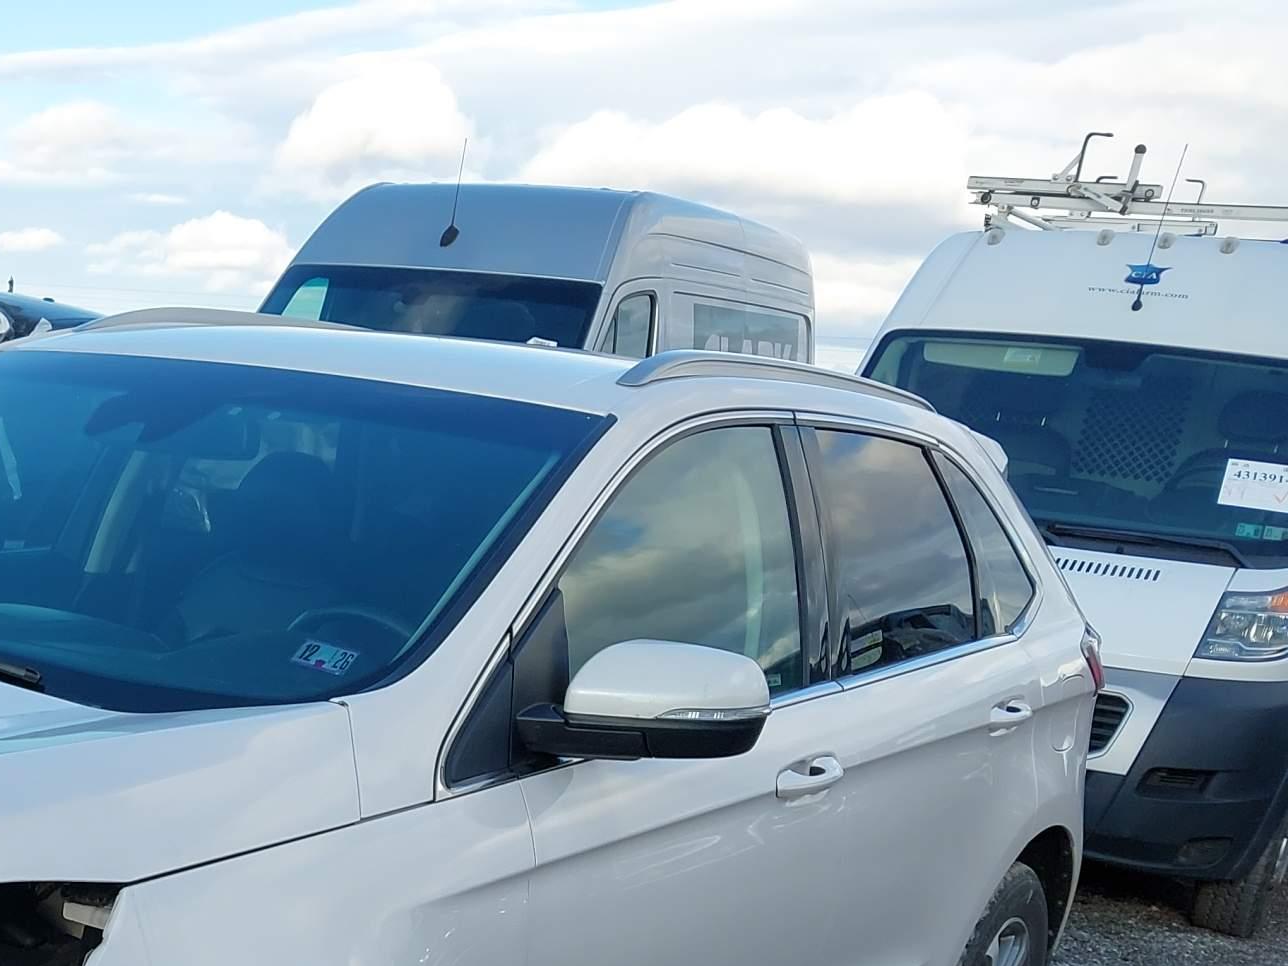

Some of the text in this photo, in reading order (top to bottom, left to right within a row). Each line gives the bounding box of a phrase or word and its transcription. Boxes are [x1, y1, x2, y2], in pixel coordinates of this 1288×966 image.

[1233, 469, 1288, 484] 431391
[298, 643, 355, 671] 12 26
